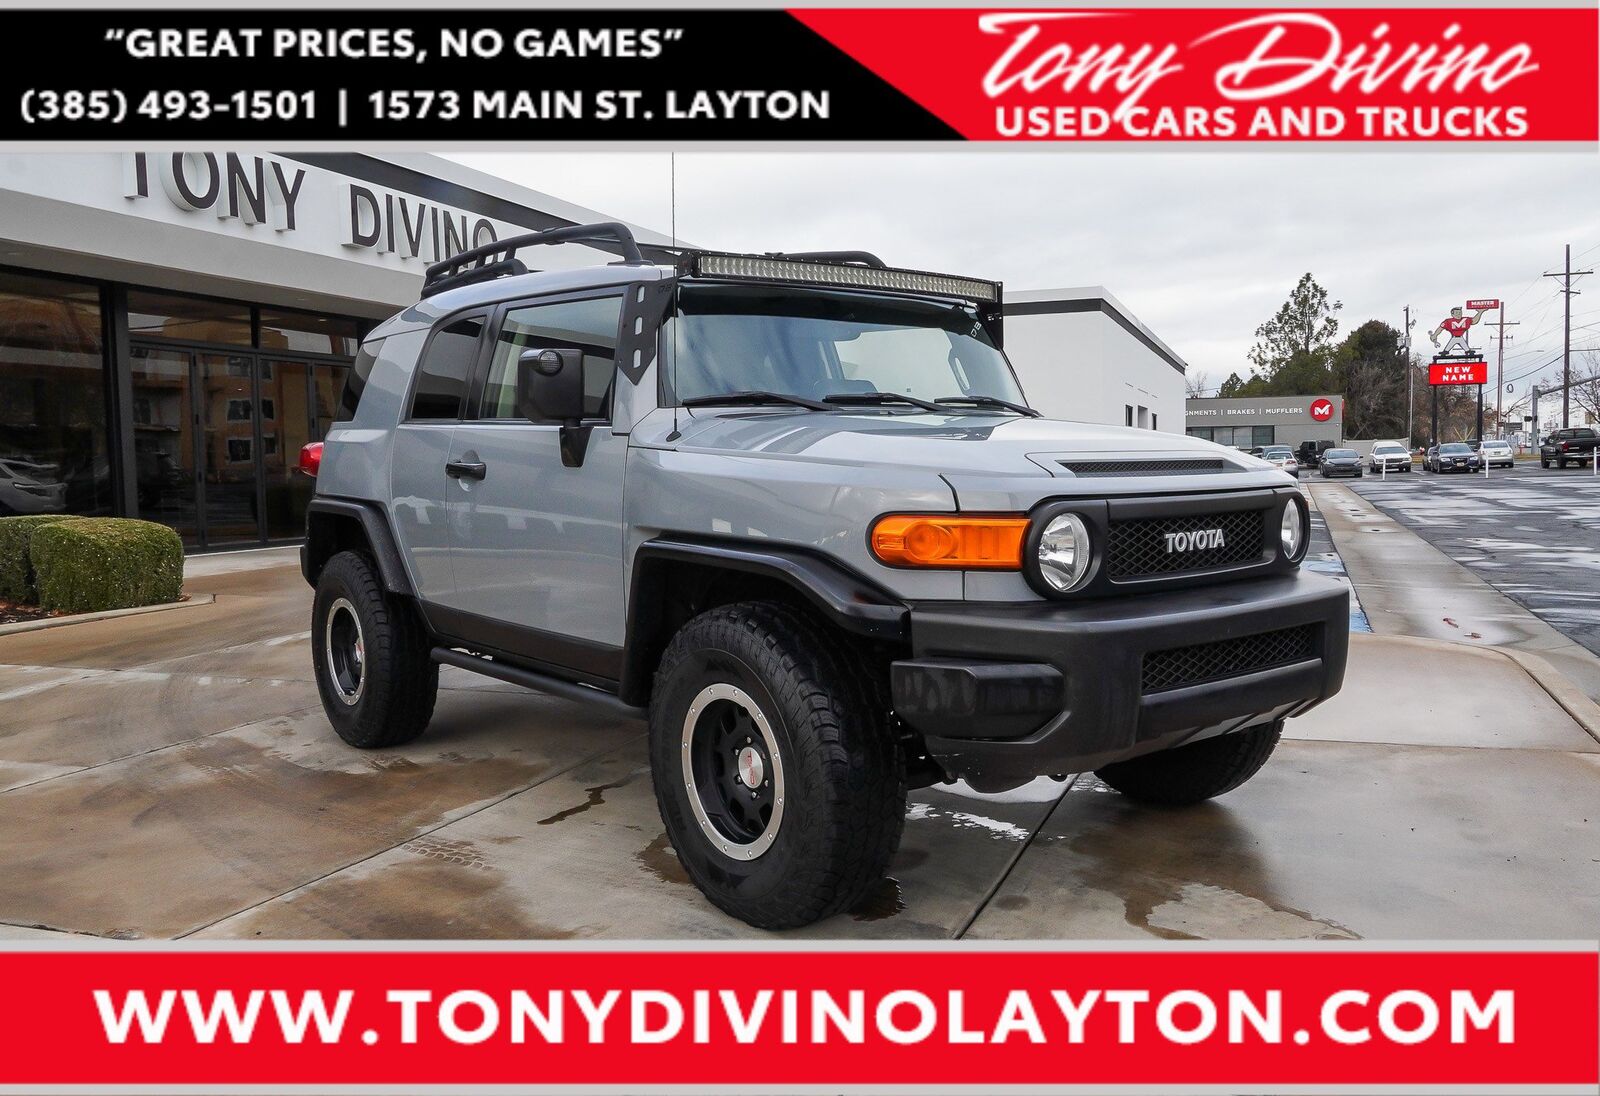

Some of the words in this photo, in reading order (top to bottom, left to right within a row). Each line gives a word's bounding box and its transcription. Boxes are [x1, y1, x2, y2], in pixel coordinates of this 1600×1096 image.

[1445, 366, 1471, 374] NEW
[1442, 374, 1474, 382] NAME
[1265, 407, 1303, 415] MUFFLERS
[1164, 528, 1225, 553] TOYOTA
